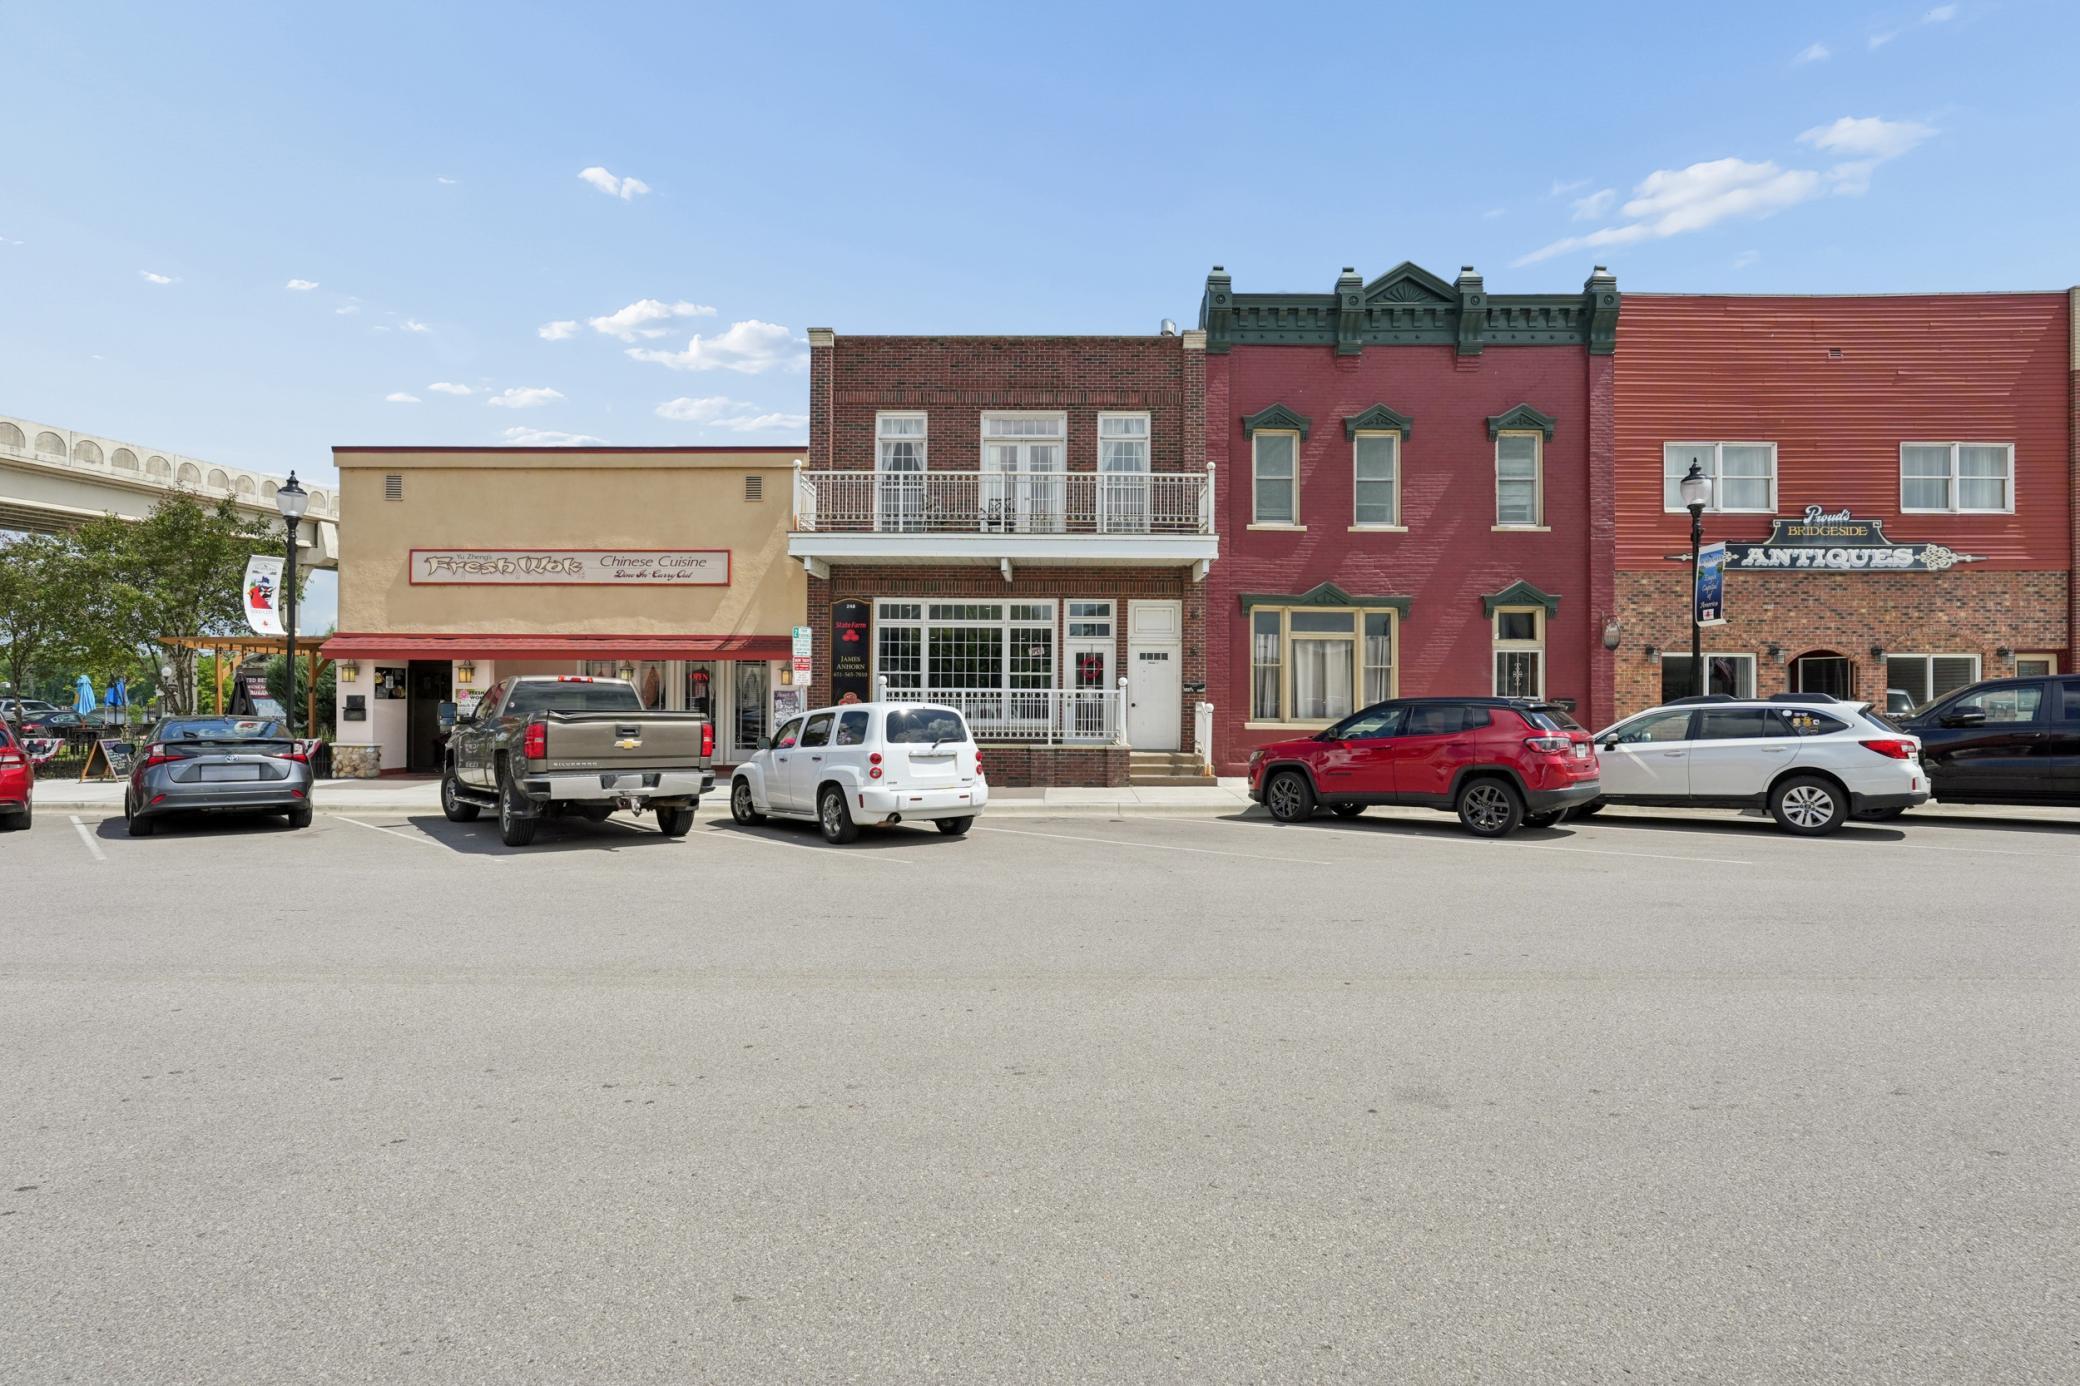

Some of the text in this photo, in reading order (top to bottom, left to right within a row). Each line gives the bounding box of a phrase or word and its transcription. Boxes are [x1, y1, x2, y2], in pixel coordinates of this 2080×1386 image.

[1803, 505, 1850, 523] Proud's
[1788, 526, 1868, 536] BRIDGESIDE
[424, 556, 583, 576] Fresh Wok
[600, 555, 707, 568] Chinese Cuisine
[1741, 548, 1914, 569] ANTIQUES
